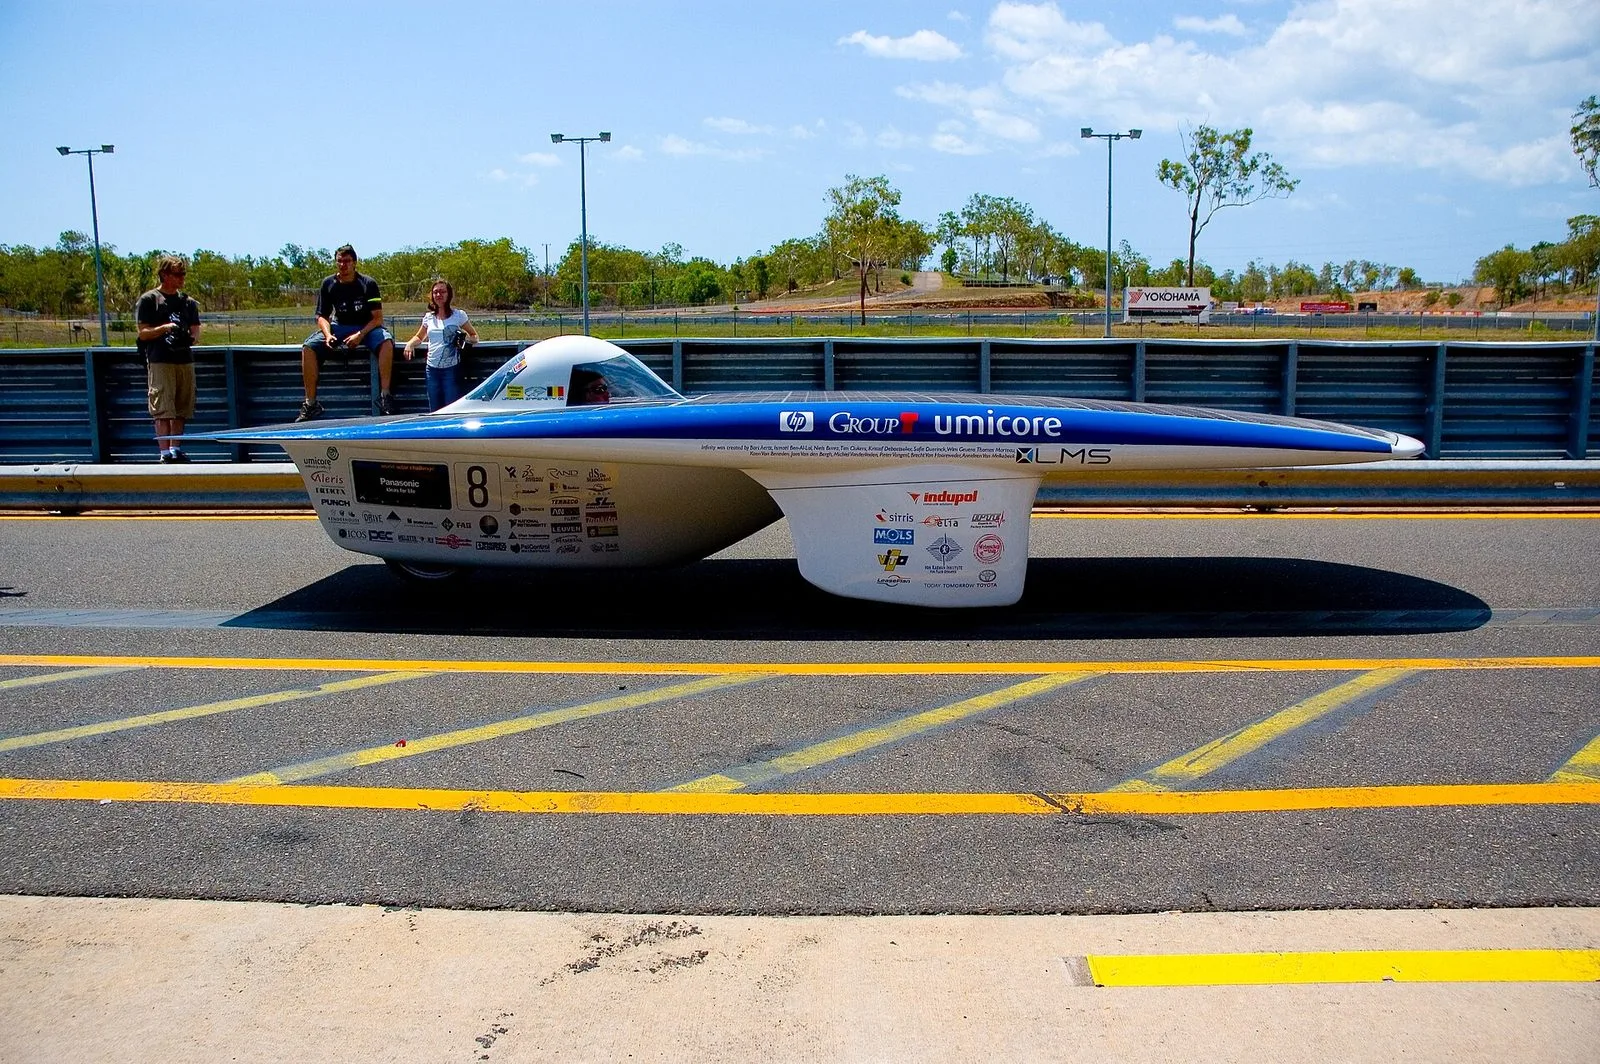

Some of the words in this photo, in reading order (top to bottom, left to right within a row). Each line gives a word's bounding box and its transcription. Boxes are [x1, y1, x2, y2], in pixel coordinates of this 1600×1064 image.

[1144, 292, 1200, 302] YOKOHAMA
[934, 409, 1062, 437] umicore
[1035, 447, 1112, 464] LMS
[303, 457, 332, 466] umicore
[311, 470, 344, 484] Aleris
[380, 477, 420, 488] Panasonic
[467, 465, 488, 508] 8
[321, 499, 351, 507] PUNCH
[923, 490, 979, 506] indupol
[888, 513, 914, 522] sirris
[936, 519, 959, 527] elia
[875, 529, 913, 541] MOLS
